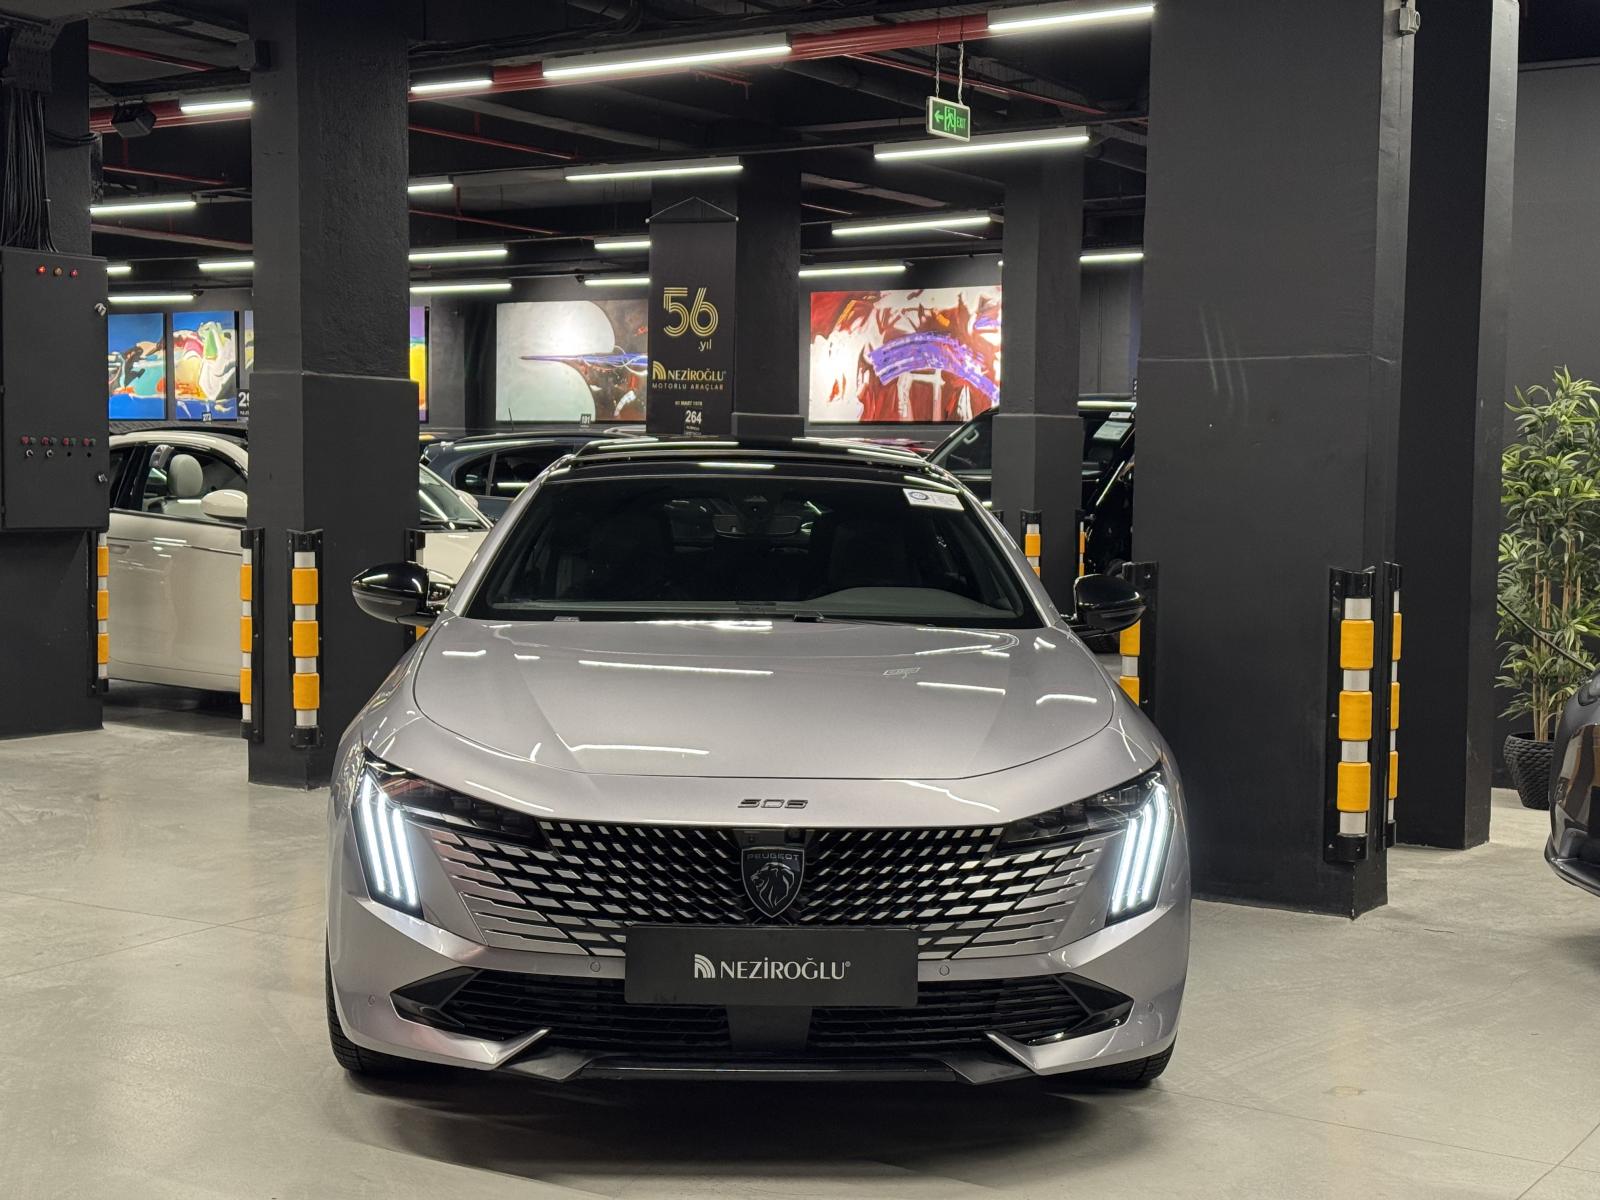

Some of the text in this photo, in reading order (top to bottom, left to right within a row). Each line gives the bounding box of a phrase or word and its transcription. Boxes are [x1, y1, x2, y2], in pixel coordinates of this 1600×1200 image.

[956, 116, 967, 129] EXIT
[663, 287, 719, 337] 56
[690, 383, 724, 392] ARAÇLAR
[685, 409, 702, 424] 264
[737, 799, 809, 809] 508
[746, 852, 799, 861] PEUGEOT
[720, 957, 846, 980] NEZİROĞLU
